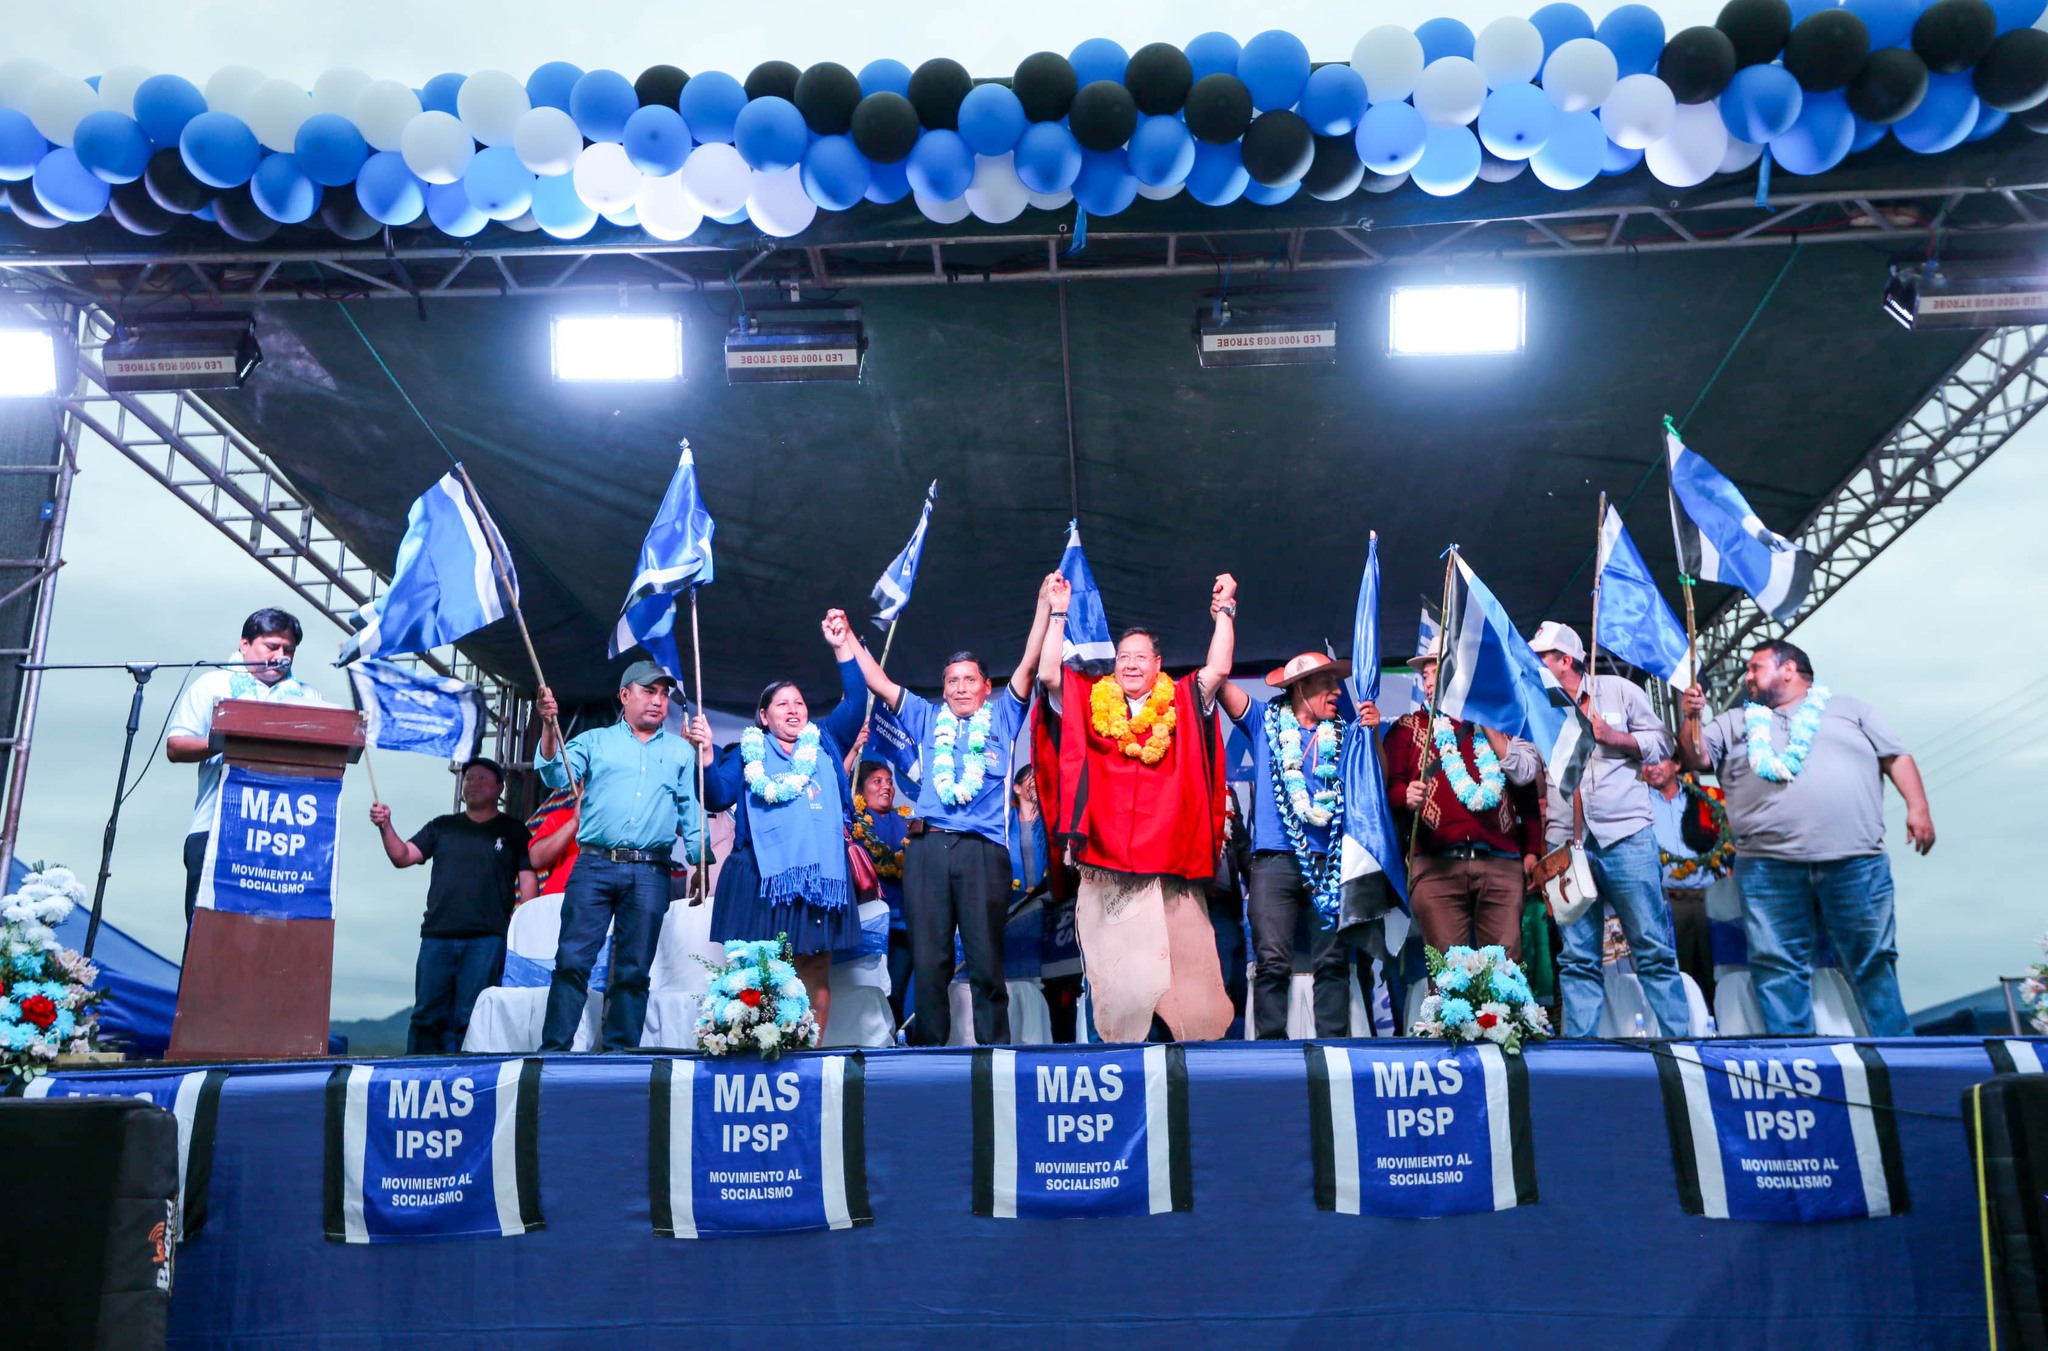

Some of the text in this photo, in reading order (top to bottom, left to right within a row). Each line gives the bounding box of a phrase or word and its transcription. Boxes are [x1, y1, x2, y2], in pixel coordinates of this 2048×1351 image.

[1217, 334, 1321, 347] LED 1000 RGB STROBE
[118, 360, 222, 373] LED 1000 RGB STROBE
[741, 353, 843, 364] LED 1000 RGB STROBE
[240, 786, 318, 826] MAS
[246, 828, 306, 857] IPSP
[231, 863, 314, 881] MOVIMIENTO AL
[239, 878, 305, 893] SOCIALISMO
[1036, 1064, 1124, 1103] MAS
[1372, 1059, 1463, 1098] MAS
[1724, 1058, 1822, 1100] MAS
[388, 1077, 475, 1119] MAS
[714, 1071, 800, 1113] MAS
[1047, 1113, 1114, 1143] IPSP
[1387, 1106, 1454, 1138] IPSP
[1744, 1109, 1816, 1141] IPSP
[396, 1128, 463, 1159] IPSP
[723, 1123, 789, 1152] IPSP
[1035, 1159, 1128, 1174] MOVIMIENTO AL
[1377, 1153, 1473, 1169] MOVIMIENTO AL
[1741, 1157, 1840, 1173] MOVIMIENTO AL
[381, 1172, 473, 1190] MOVIMIENTO AL
[709, 1168, 802, 1183] MOVIMIENTO AL
[1046, 1176, 1119, 1191] SOCIALISMO
[1389, 1171, 1463, 1186] SOCIALISMO
[1756, 1175, 1832, 1190] SOCIALISMO
[392, 1190, 463, 1207] SOCIALISMO
[721, 1185, 793, 1201] SOCIALISMO
